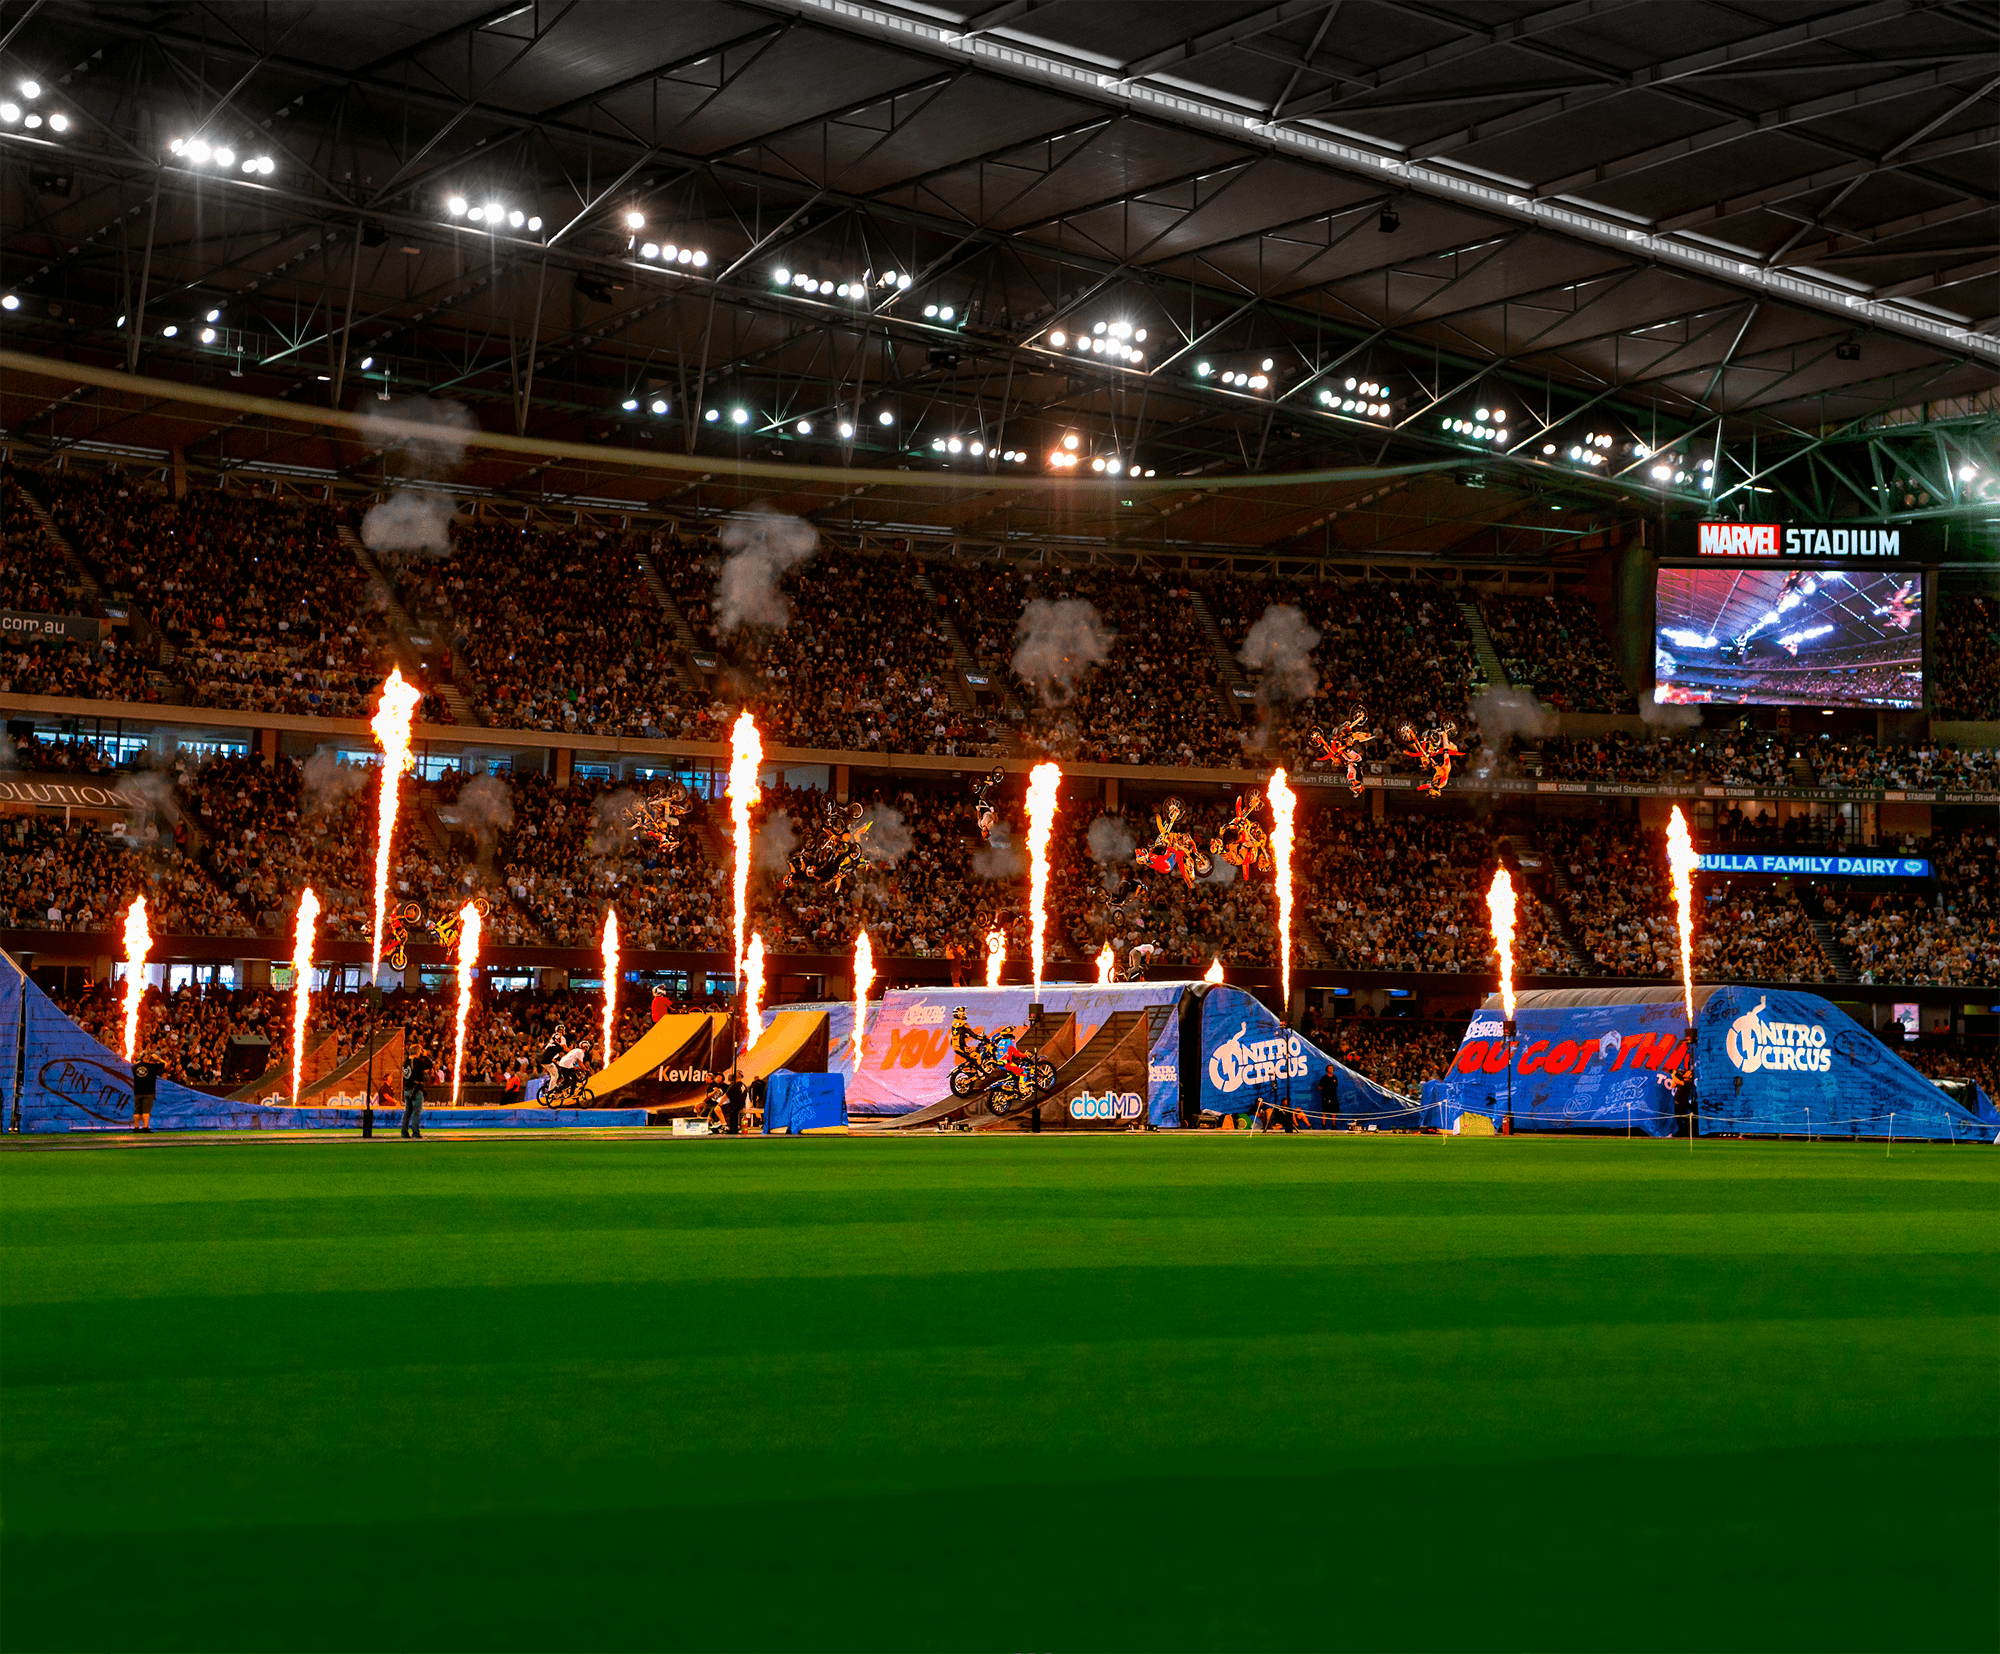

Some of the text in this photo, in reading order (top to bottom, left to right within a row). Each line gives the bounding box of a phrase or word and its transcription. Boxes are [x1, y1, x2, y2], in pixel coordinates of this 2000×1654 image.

[1700, 525, 1900, 556] MARVEL STADIUM
[2, 617, 65, 634] com.au
[1287, 774, 1316, 784] tadium
[1318, 775, 1338, 784] FREE
[1383, 778, 1411, 787] STADIUM
[1559, 783, 1587, 792] STADIUM
[1596, 784, 1622, 793] Marvel
[1623, 784, 1657, 794] Stadium
[1726, 788, 1755, 797] STADIUM
[1763, 789, 1876, 799] EPIC LIVES HERE
[1906, 792, 1936, 801] STADIUM
[1945, 793, 1973, 802] Marvel
[1762, 856, 1833, 872] FAMILY
[1838, 858, 1899, 874] DAIRY
[1761, 1021, 1827, 1049] NITRO
[880, 1028, 951, 1070] YOU
[1242, 1036, 1301, 1066] NITRO
[1517, 1038, 1600, 1075] GOT
[1762, 1045, 1831, 1072] CIRCUS
[59, 1062, 92, 1094] PIN
[658, 1065, 708, 1082] Kevlar
[1242, 1055, 1308, 1085] CIRCUS
[1070, 1091, 1143, 1120] cbdMD
